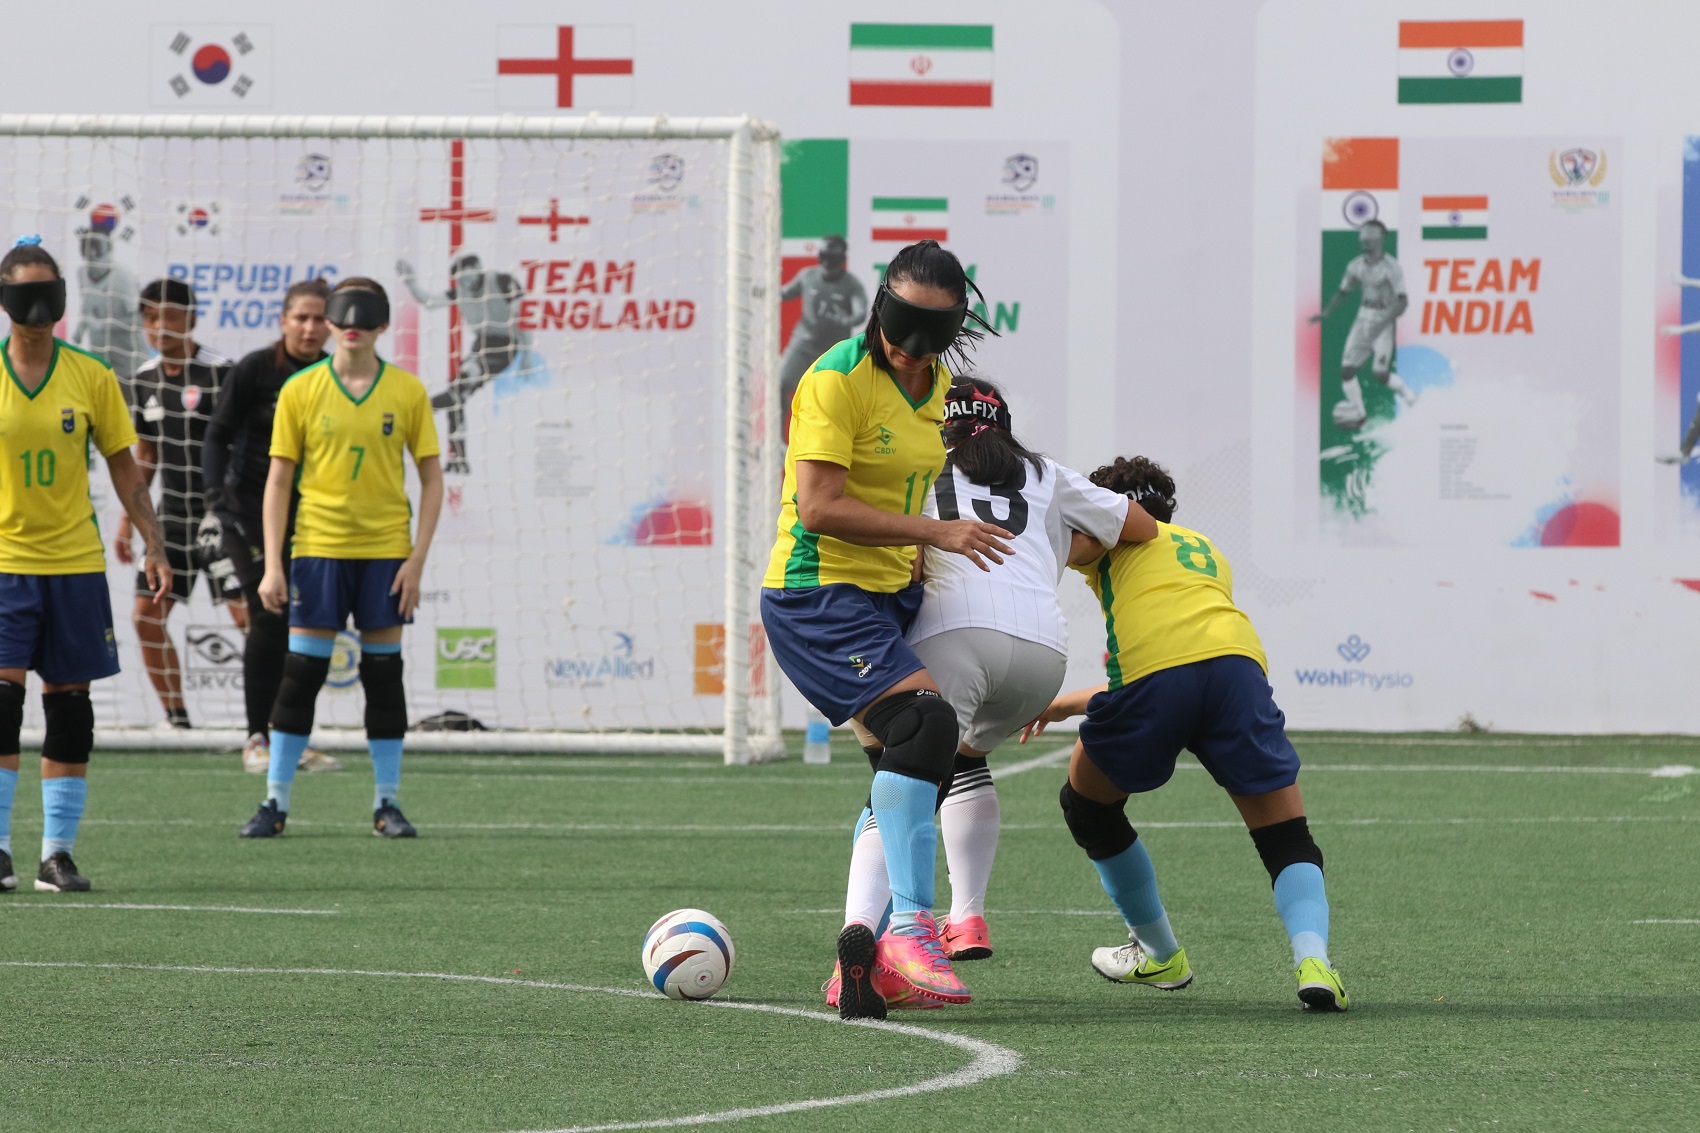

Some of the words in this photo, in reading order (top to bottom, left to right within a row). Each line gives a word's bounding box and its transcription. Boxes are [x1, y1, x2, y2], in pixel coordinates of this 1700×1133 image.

[520, 260, 637, 294] TEAM
[1422, 258, 1541, 292] TEAM
[218, 300, 282, 329] KOR
[517, 300, 696, 330] ENGLAND
[966, 302, 1020, 332] AN
[1420, 300, 1535, 334] INDIA
[944, 400, 998, 421] OALFIX
[349, 446, 365, 480] 7
[874, 446, 896, 454] CBDV
[20, 449, 55, 488] 10
[903, 469, 933, 516] 11
[934, 455, 1028, 537] 13
[1170, 532, 1218, 578] 8
[858, 662, 872, 678] CBDV
[1295, 669, 1414, 691] WohlPhysio
